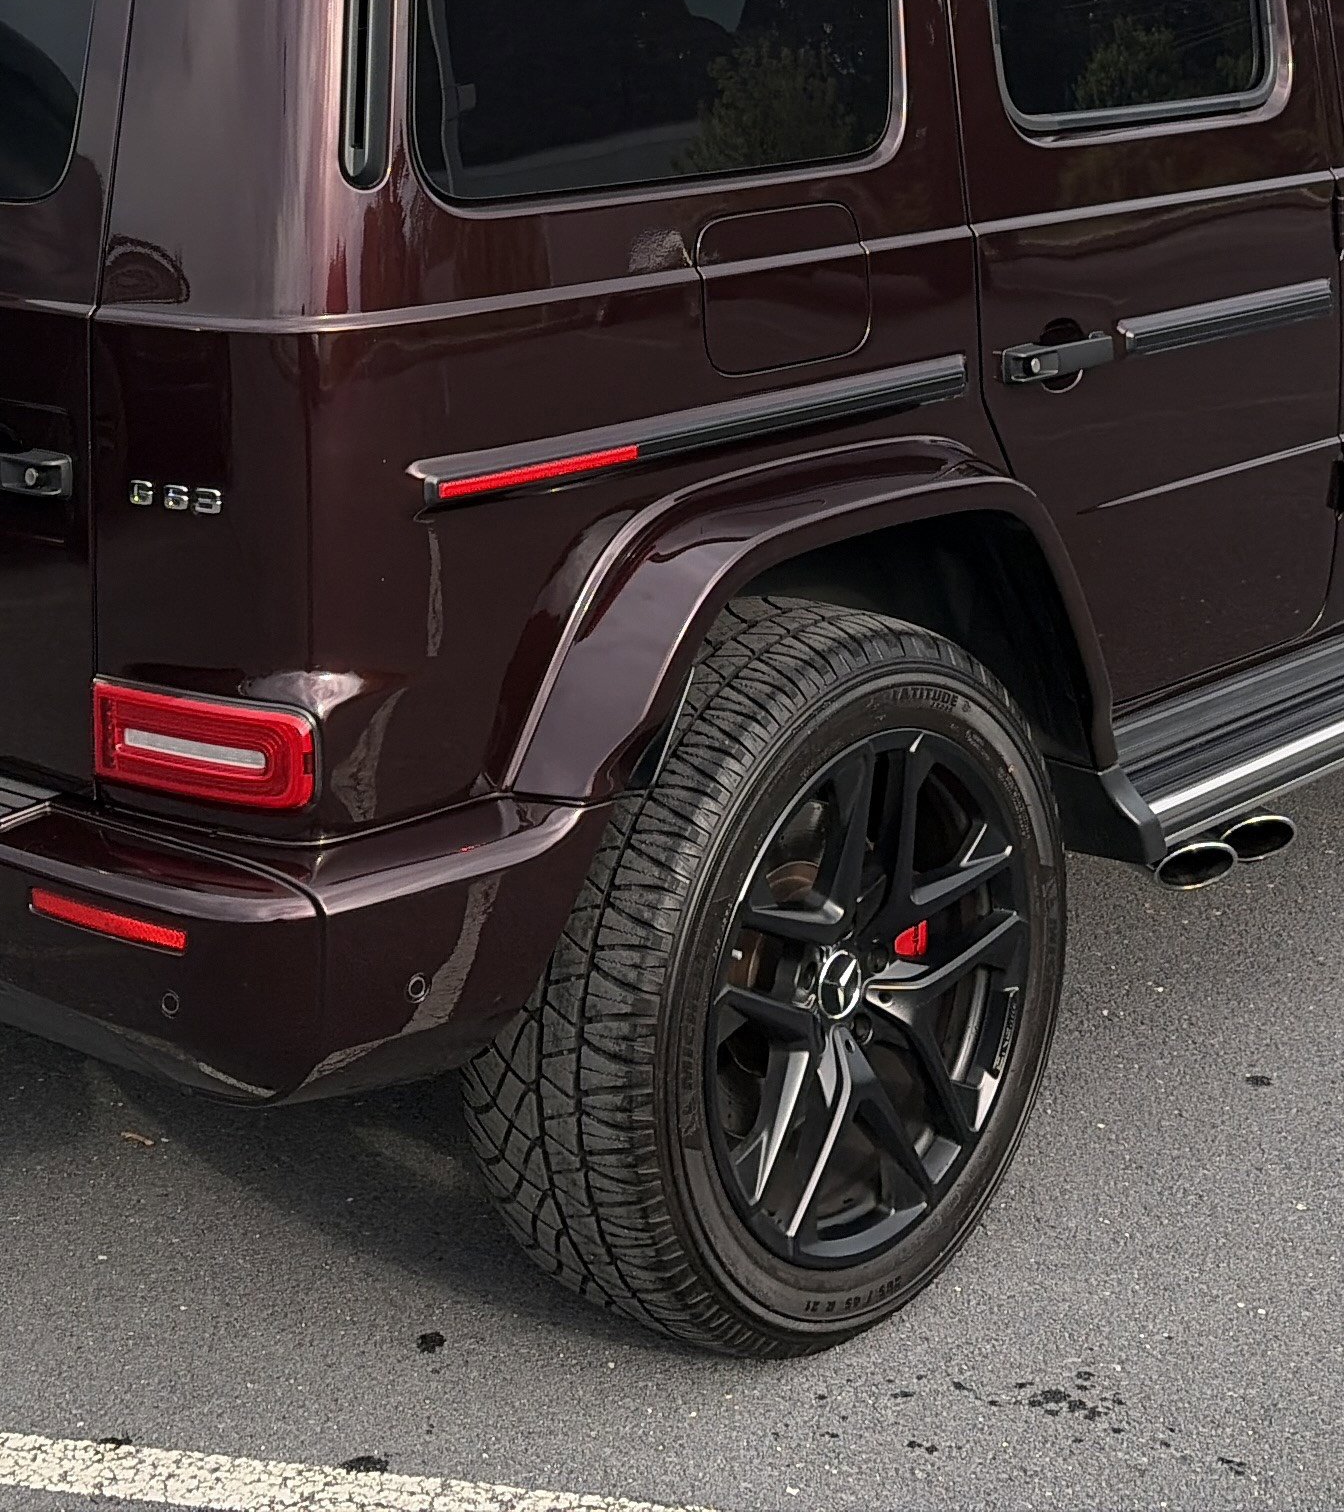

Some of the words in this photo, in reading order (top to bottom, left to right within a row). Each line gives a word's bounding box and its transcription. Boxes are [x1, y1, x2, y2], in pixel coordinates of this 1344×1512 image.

[129, 479, 154, 506] G
[163, 484, 223, 515] 63
[892, 686, 959, 707] LATITUDE
